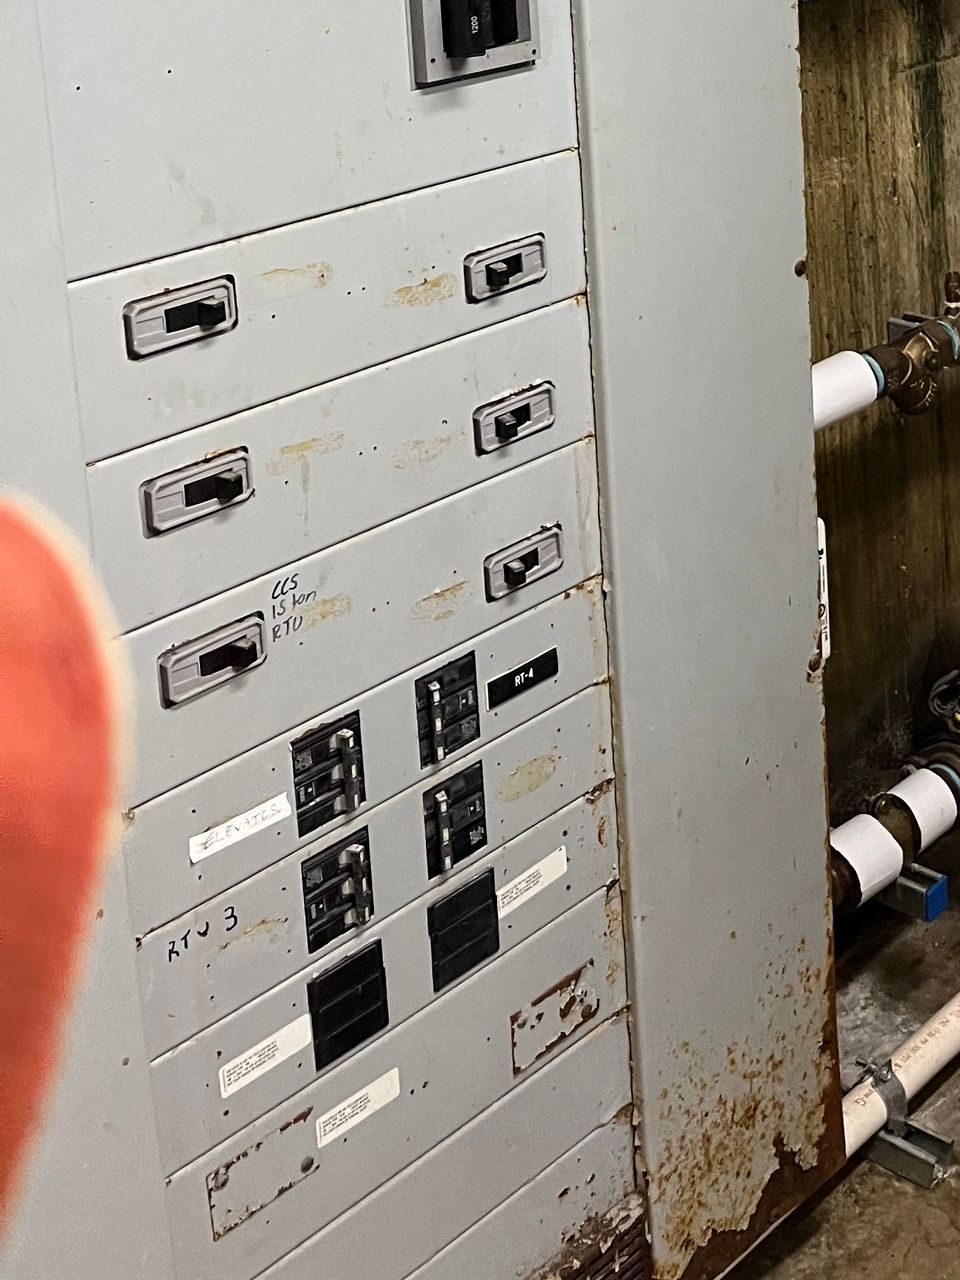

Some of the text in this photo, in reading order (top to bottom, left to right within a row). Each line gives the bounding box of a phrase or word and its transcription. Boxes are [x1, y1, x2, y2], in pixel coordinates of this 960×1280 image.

[471, 15, 479, 34] 1200
[514, 667, 534, 687] RT-4
[224, 906, 238, 931] 3
